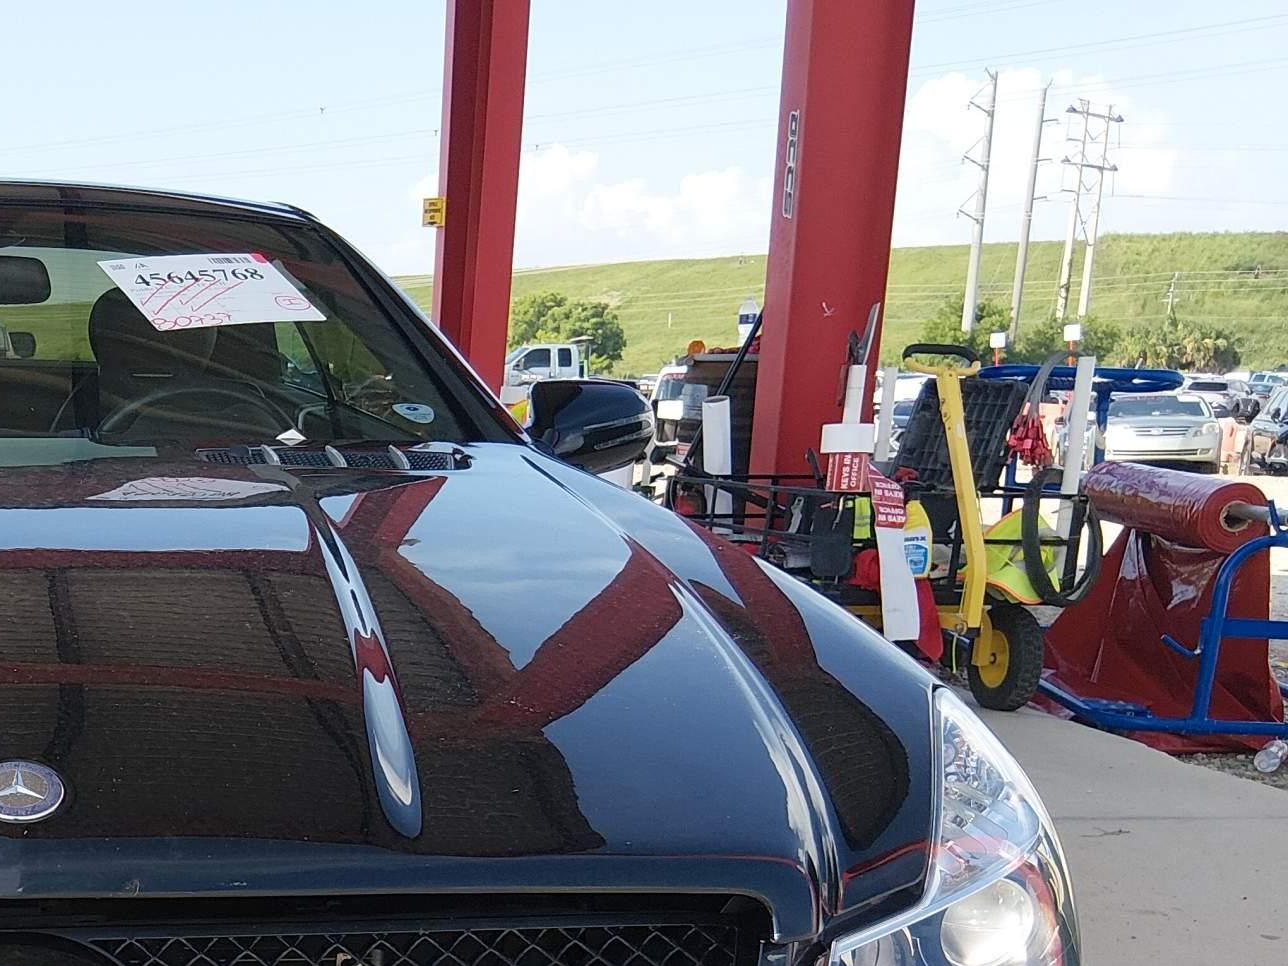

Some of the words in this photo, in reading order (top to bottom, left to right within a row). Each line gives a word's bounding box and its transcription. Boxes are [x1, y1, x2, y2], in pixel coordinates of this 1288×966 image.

[134, 267, 265, 287] 45645768
[840, 465, 850, 489] KEYS
[850, 457, 859, 486] OFFICE
